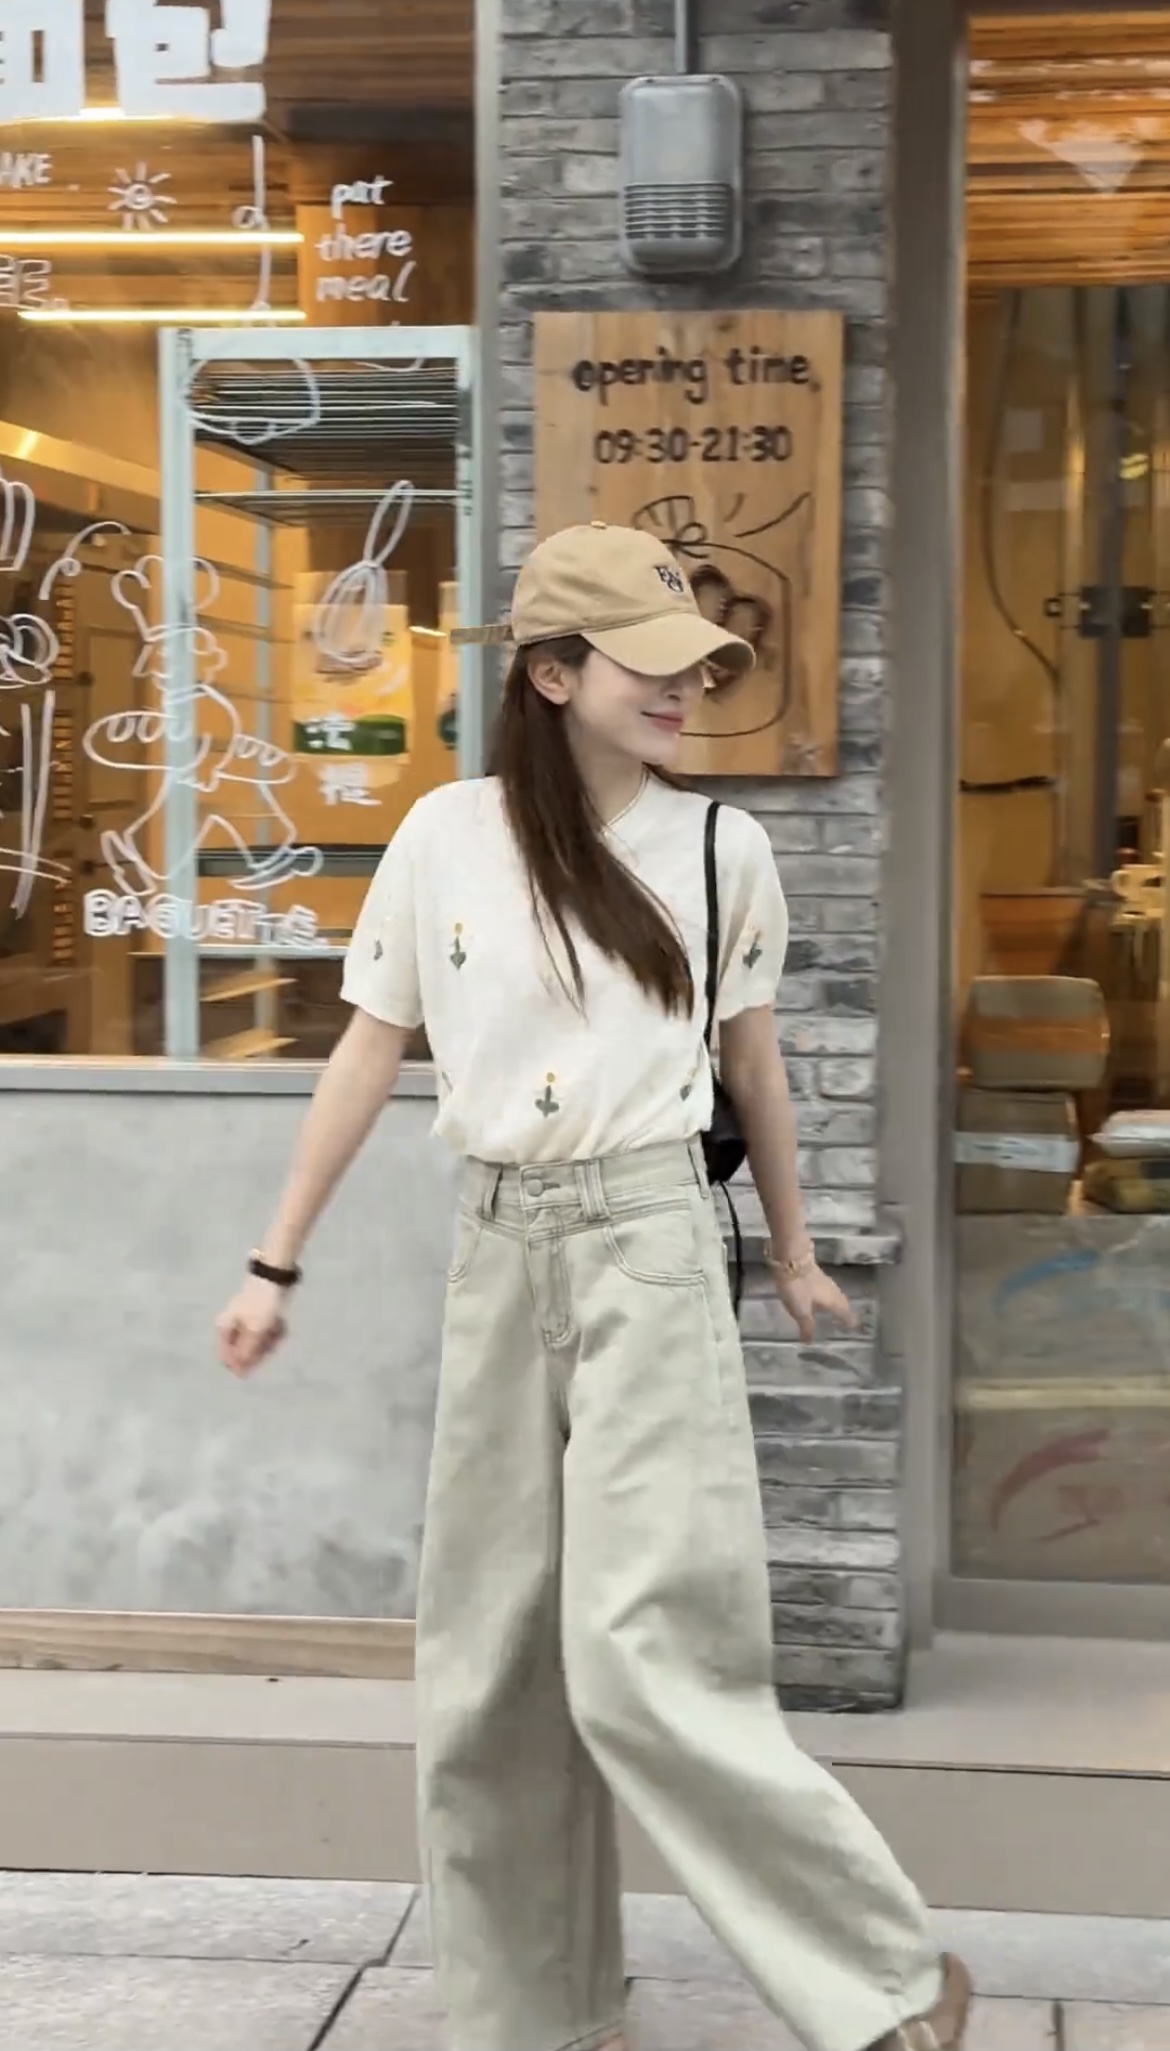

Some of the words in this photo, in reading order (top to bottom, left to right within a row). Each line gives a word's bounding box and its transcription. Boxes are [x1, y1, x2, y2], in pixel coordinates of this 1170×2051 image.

[315, 222, 412, 260] there
[316, 261, 416, 302] meal
[573, 347, 708, 406] opening
[595, 425, 792, 464] 09:30-21:30
